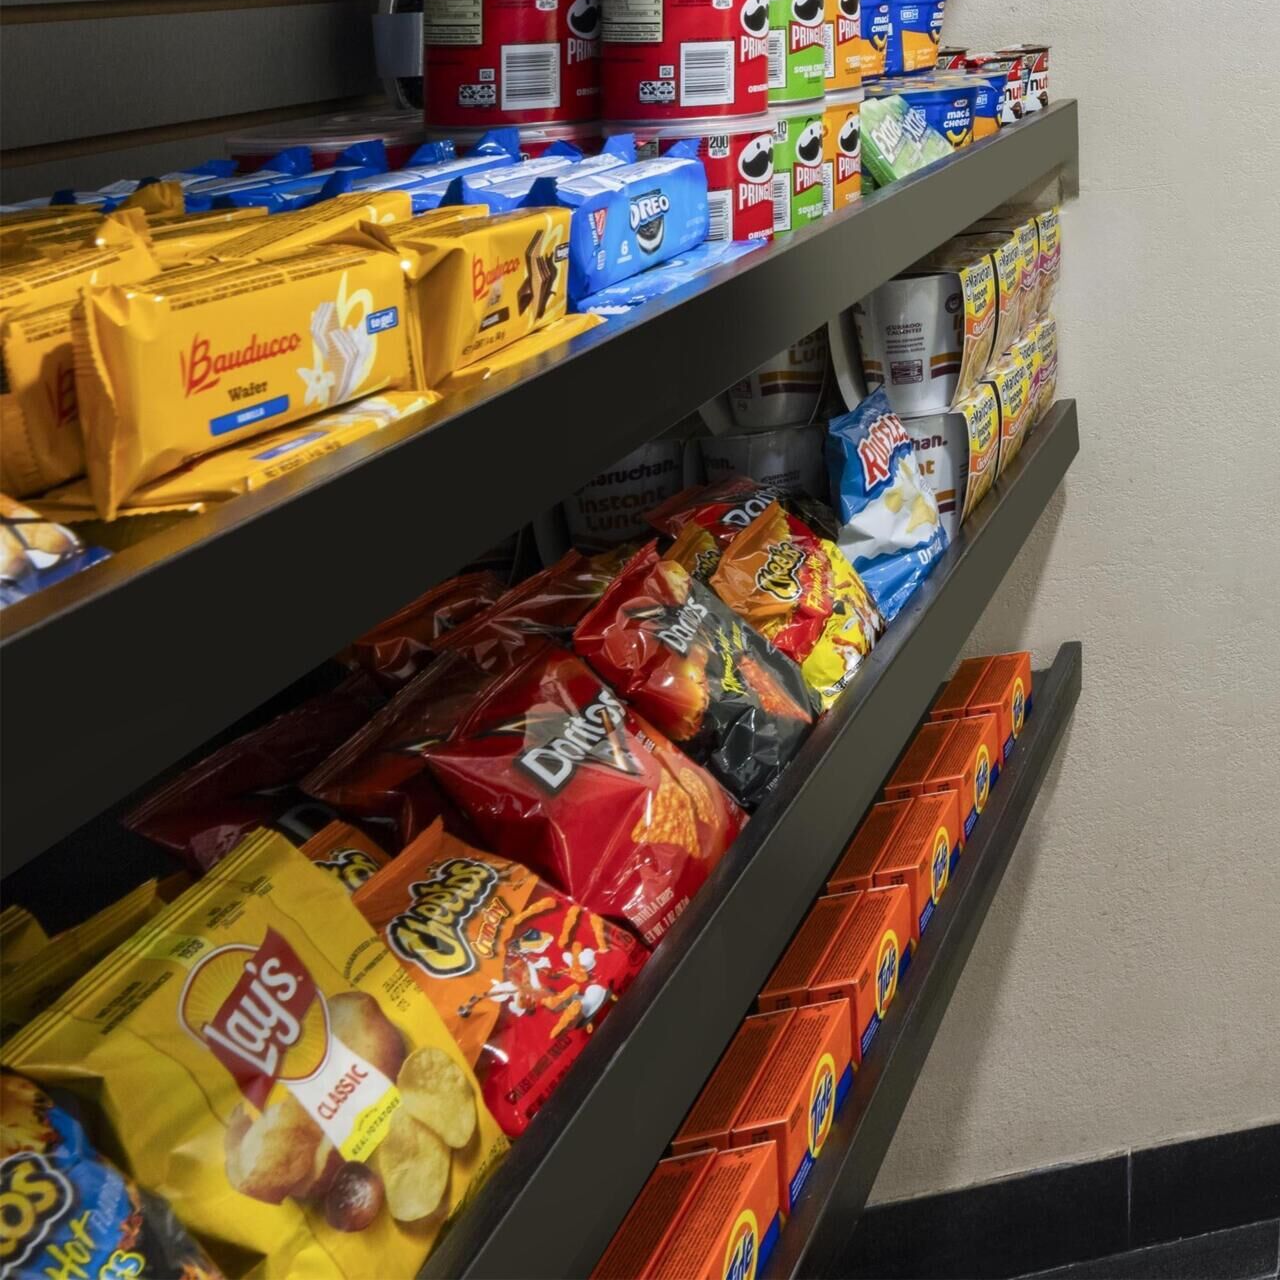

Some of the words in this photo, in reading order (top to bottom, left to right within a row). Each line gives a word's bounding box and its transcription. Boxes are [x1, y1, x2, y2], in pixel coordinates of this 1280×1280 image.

[709, 135, 729, 149] 200
[630, 195, 670, 229] OREO
[621, 240, 629, 255] 6
[180, 332, 302, 398] Bauducco
[227, 381, 268, 402] Wafer
[657, 595, 709, 654] Doritos
[520, 689, 626, 789] Doritos
[931, 840, 948, 899] Tide
[395, 860, 492, 974] Cheetos
[876, 942, 898, 1012] Tide
[203, 957, 298, 1077] Lay's
[317, 1064, 369, 1121] CLASSIC
[811, 1071, 833, 1153] Tide
[352, 1138, 368, 1155] REAL
[366, 1096, 400, 1141] POTATOES
